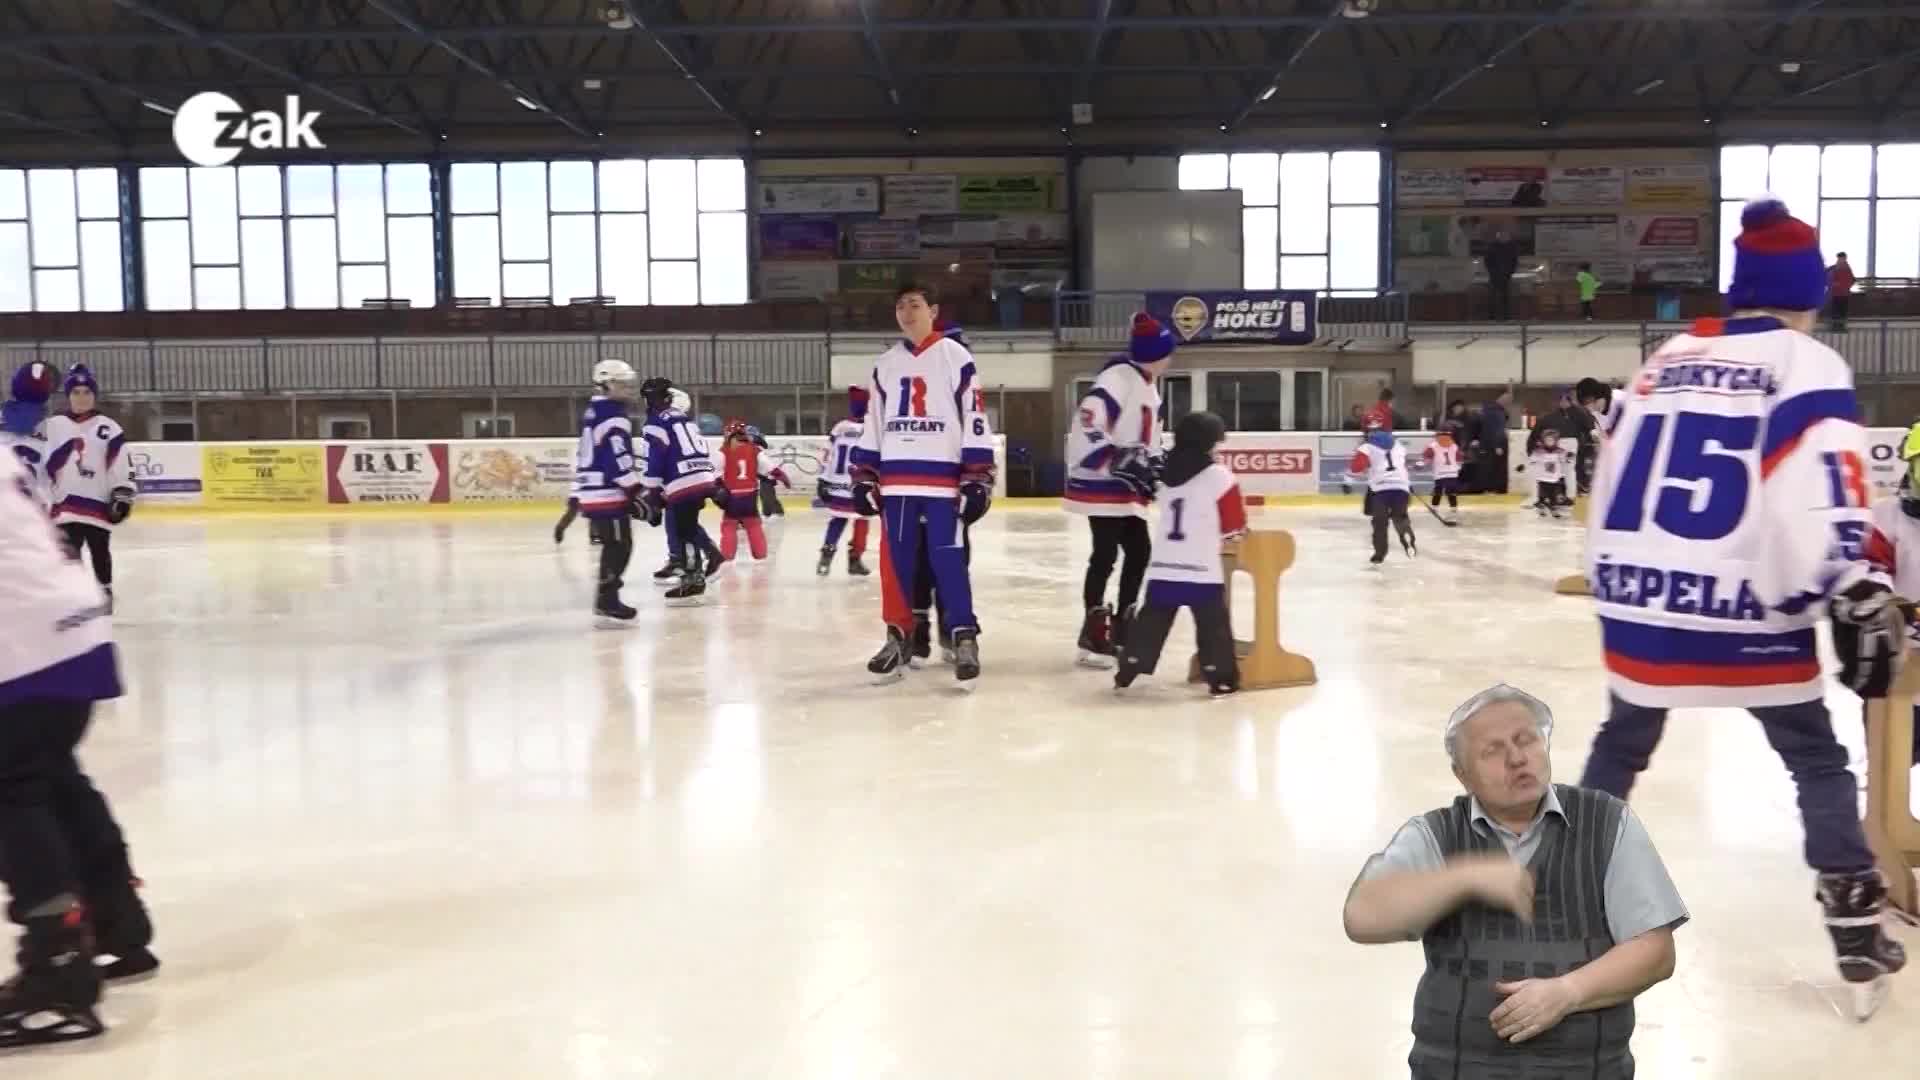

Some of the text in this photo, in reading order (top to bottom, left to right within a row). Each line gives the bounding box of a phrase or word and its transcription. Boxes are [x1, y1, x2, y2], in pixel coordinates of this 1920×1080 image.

[1214, 312, 1285, 328] HOKEJ
[973, 417, 984, 436] 6
[735, 459, 748, 479] 1
[1384, 450, 1396, 471] 1
[1604, 411, 1761, 540] 15
[1166, 498, 1186, 541] 1
